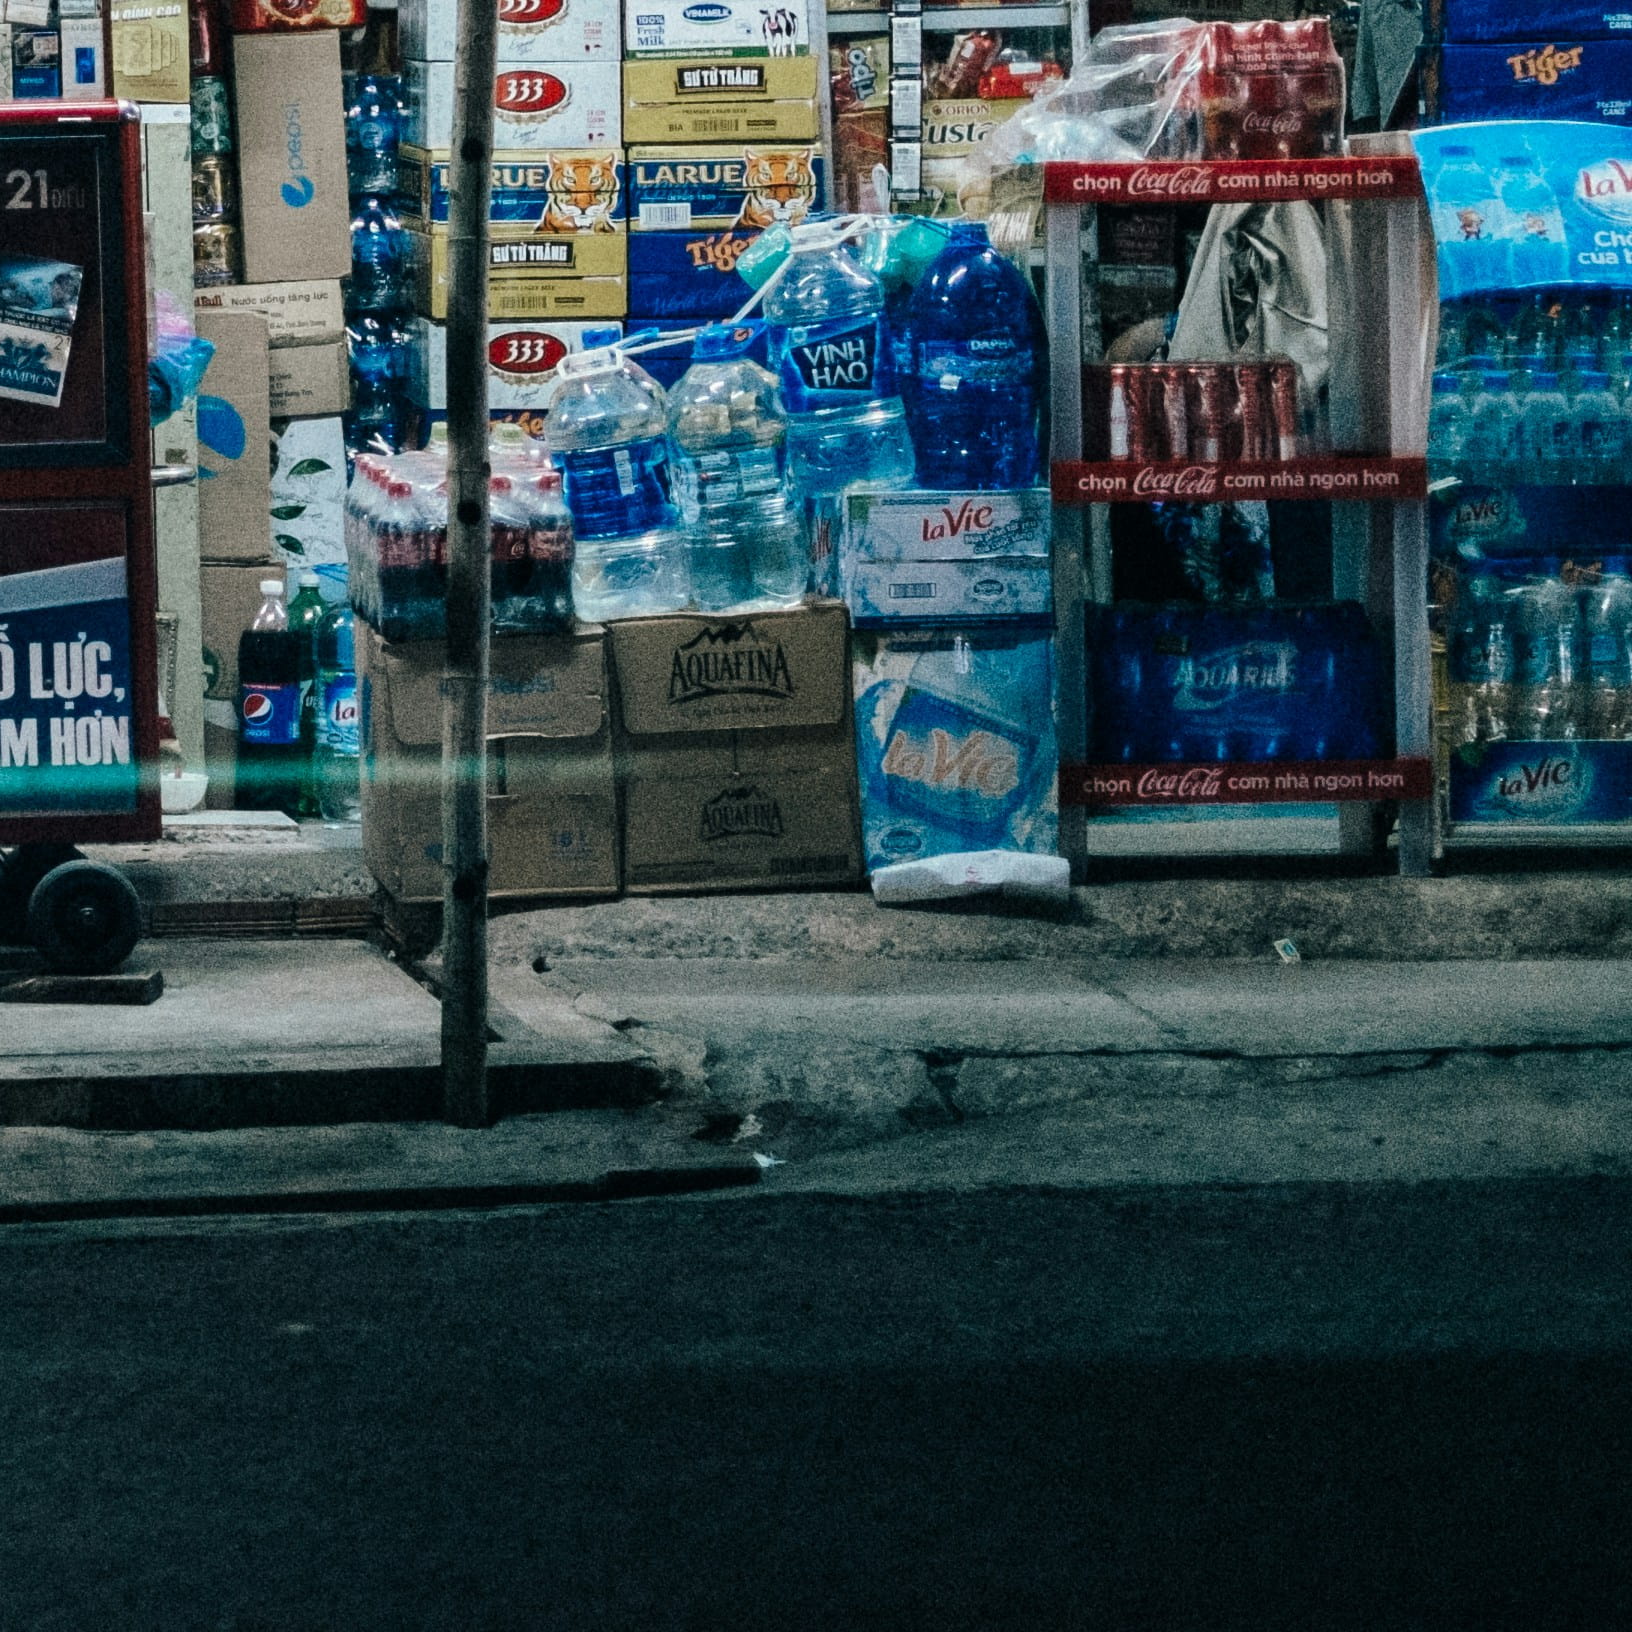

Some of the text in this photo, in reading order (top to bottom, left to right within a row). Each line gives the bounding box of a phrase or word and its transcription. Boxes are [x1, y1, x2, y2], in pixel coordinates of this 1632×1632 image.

[636, 36, 666, 47] Milk
[1506, 44, 1584, 86] Tiger
[501, 77, 544, 104] 333
[637, 164, 743, 185] LARUE
[1072, 169, 1122, 195] chọn
[1264, 168, 1300, 188] nhà
[1303, 171, 1354, 194] ngon
[502, 338, 546, 365] 333
[1077, 471, 1128, 495] chọn
[1269, 468, 1306, 487] nhà
[1308, 471, 1360, 494] ngon
[49, 713, 131, 768] HƠN
[1082, 774, 1132, 797] chọn
[1273, 770, 1311, 789] nhà
[1313, 773, 1364, 796] ngon
